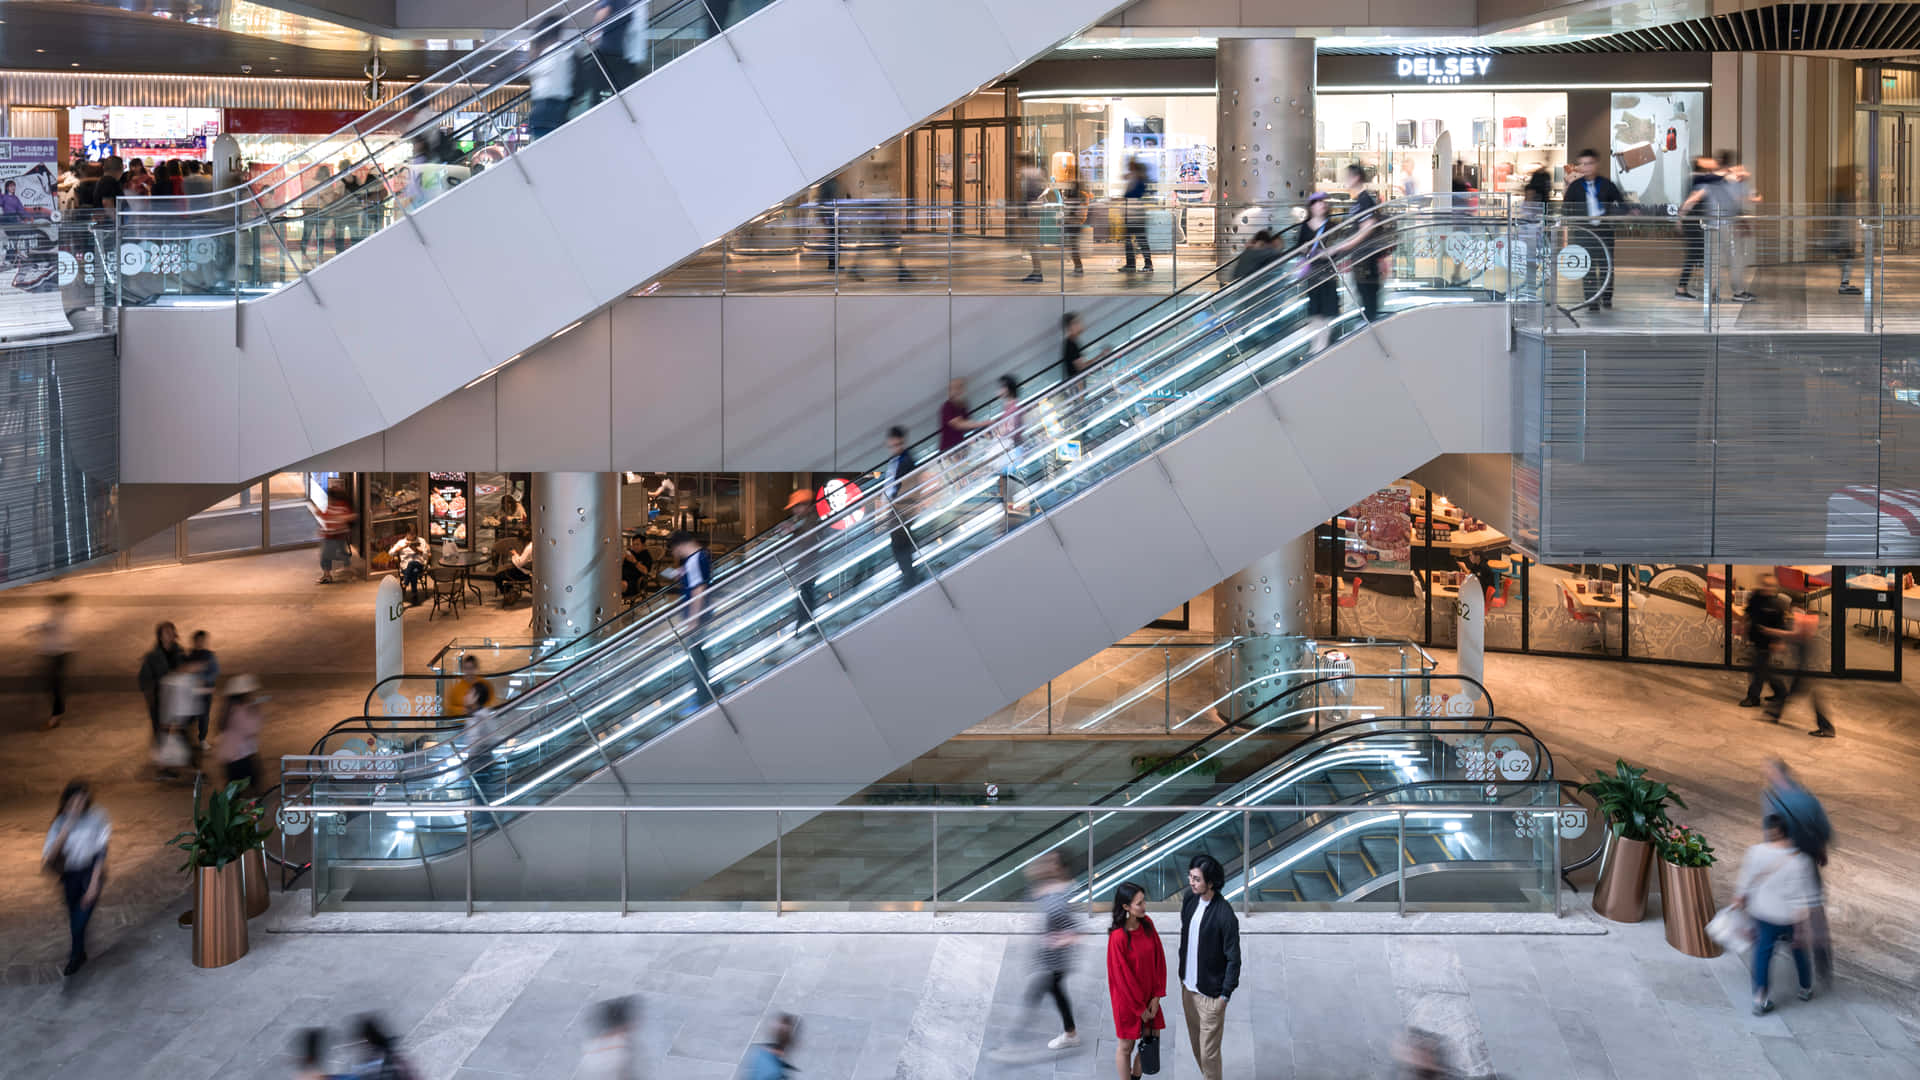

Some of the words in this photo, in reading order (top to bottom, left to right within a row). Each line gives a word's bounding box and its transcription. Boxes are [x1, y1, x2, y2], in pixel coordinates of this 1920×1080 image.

[1398, 57, 1491, 76] DELSEY
[1427, 76, 1460, 84] PARIS
[1502, 759, 1530, 773] LG2
